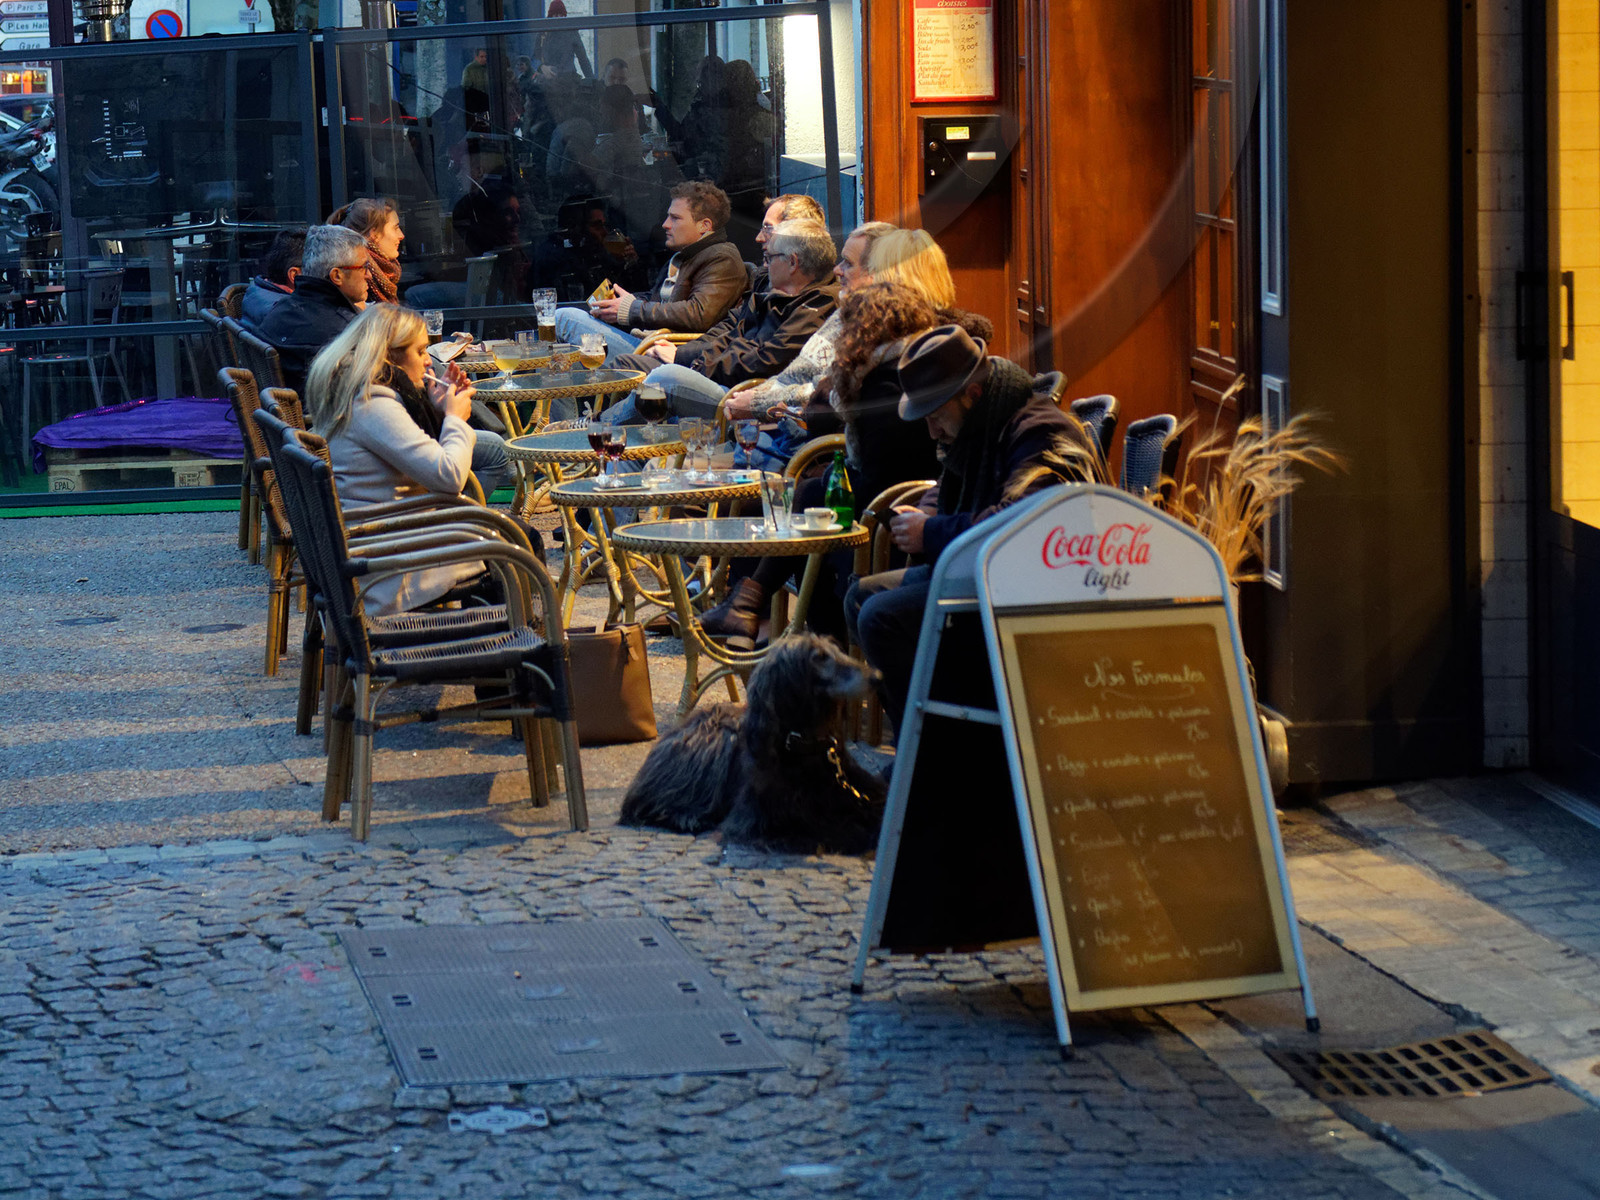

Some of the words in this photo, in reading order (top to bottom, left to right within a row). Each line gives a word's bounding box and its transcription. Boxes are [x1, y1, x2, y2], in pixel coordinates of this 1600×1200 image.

[32, 22, 49, 30] Hall
[19, 42, 41, 50] Gare
[1042, 523, 1153, 570] Coca-Cola
[1084, 567, 1131, 595] light
[1084, 657, 1126, 688] Nos
[1132, 660, 1206, 686] Formules
